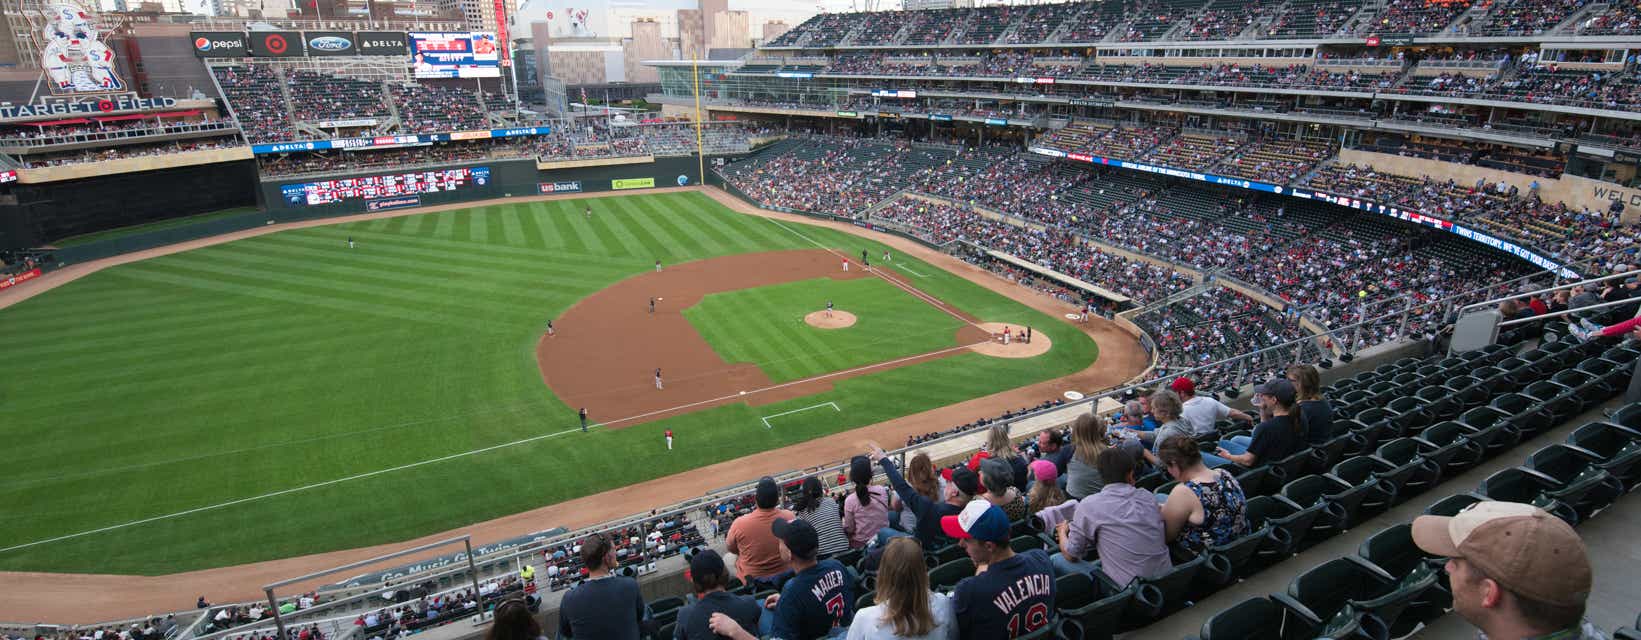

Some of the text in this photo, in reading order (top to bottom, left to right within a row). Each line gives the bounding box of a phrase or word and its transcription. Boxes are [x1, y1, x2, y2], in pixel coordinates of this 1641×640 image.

[212, 39, 242, 49] pepsi
[317, 39, 343, 49] Ford
[0, 97, 177, 118] TARGET FIELD
[1223, 178, 1241, 186] DELTA
[1456, 225, 1473, 239] TWINS
[1520, 248, 1530, 259] GOT
[1530, 252, 1544, 266] YOUR
[409, 557, 450, 574] Music
[811, 570, 844, 601] MAUER
[992, 573, 1051, 615] VALENCIA
[825, 592, 845, 629] 7
